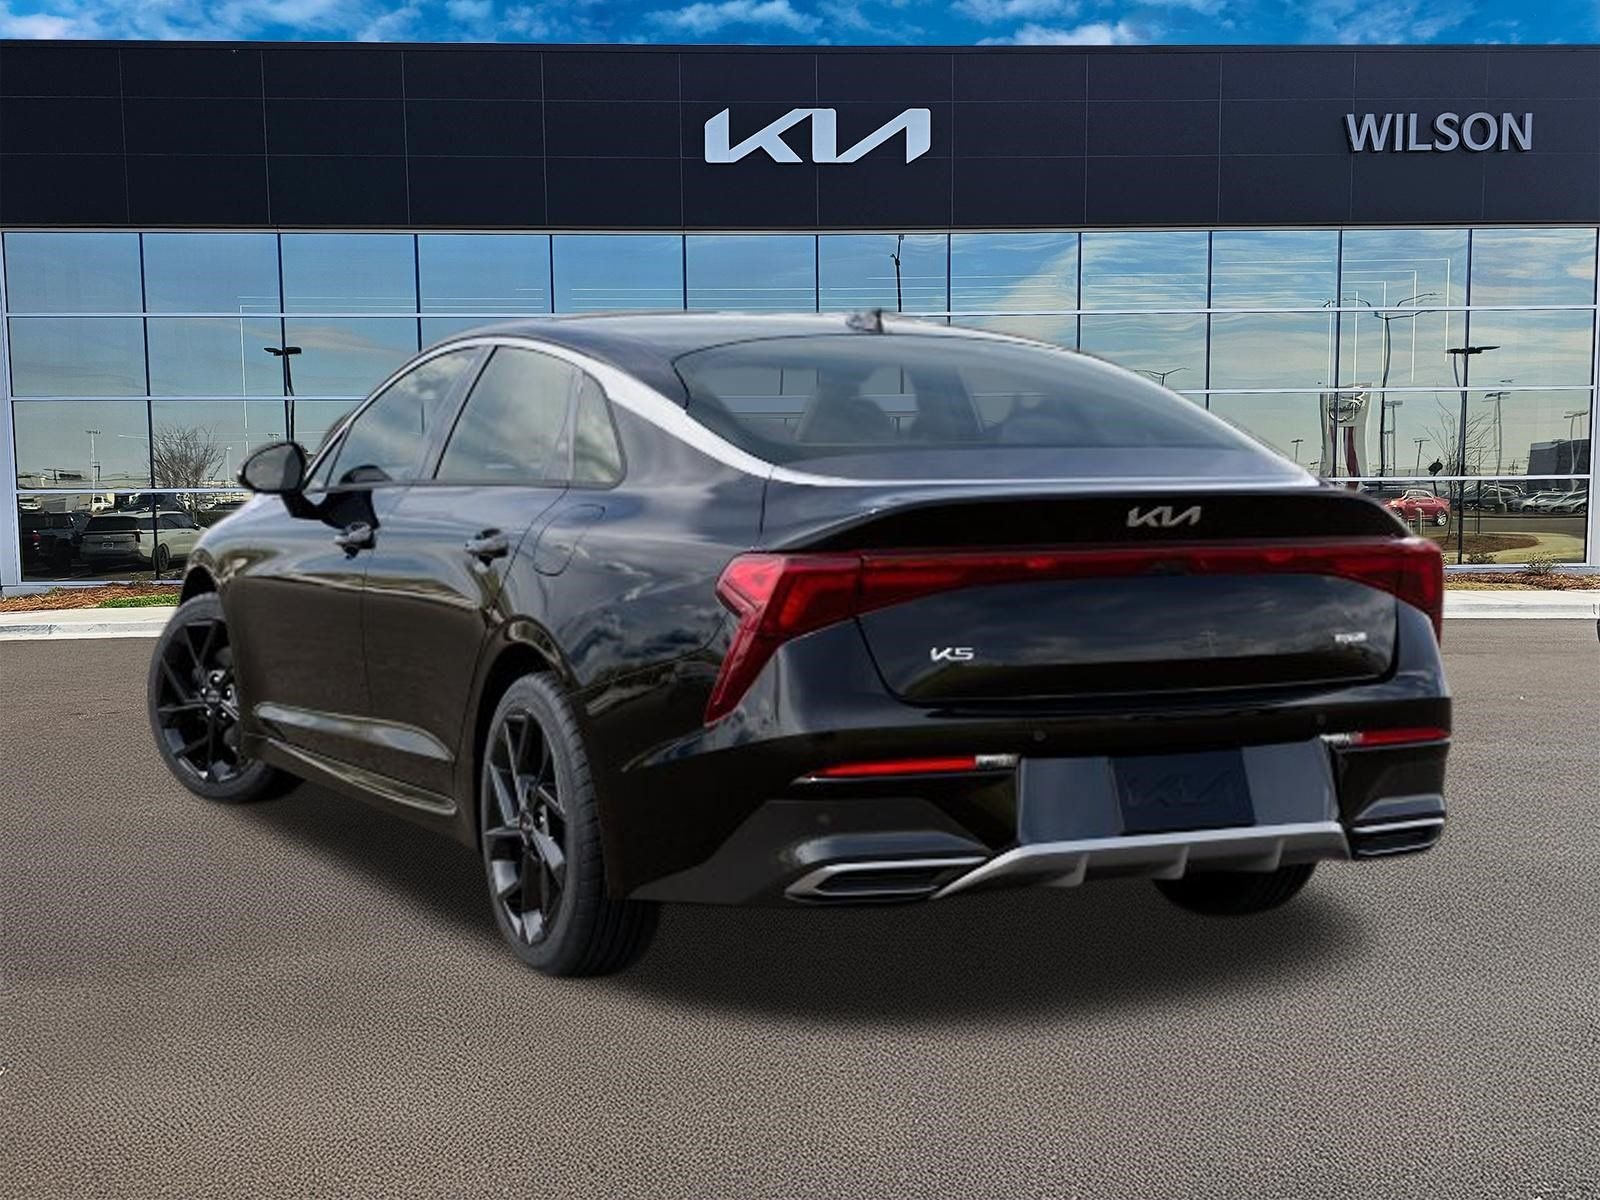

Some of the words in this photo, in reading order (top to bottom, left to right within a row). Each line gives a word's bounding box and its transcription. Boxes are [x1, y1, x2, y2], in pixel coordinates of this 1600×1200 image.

[704, 108, 931, 164] KIA
[1346, 112, 1533, 152] WILSON
[930, 647, 975, 661] K5
